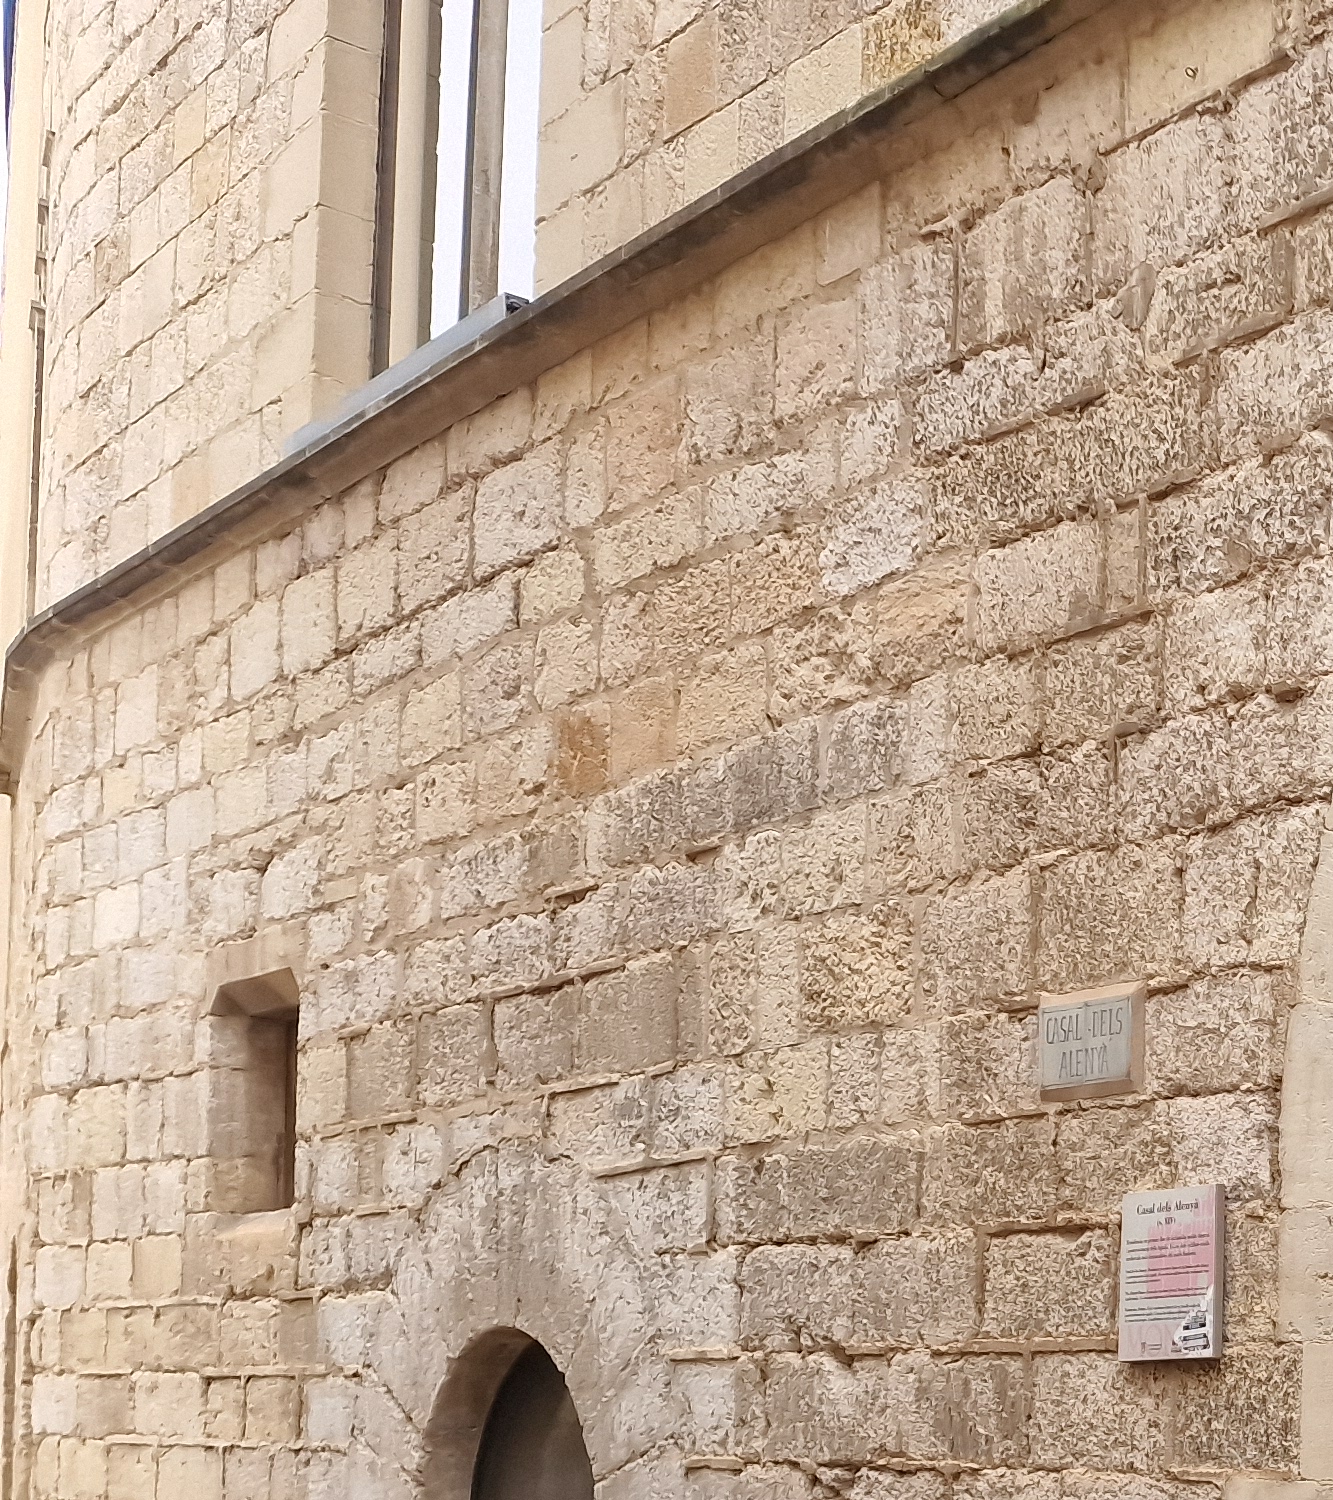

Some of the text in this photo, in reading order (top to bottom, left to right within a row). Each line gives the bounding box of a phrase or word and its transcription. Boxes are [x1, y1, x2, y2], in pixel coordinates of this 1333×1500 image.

[1046, 1013, 1082, 1044] CASAL
[1136, 1202, 1156, 1216] Casal
[1156, 1200, 1172, 1213] dels
